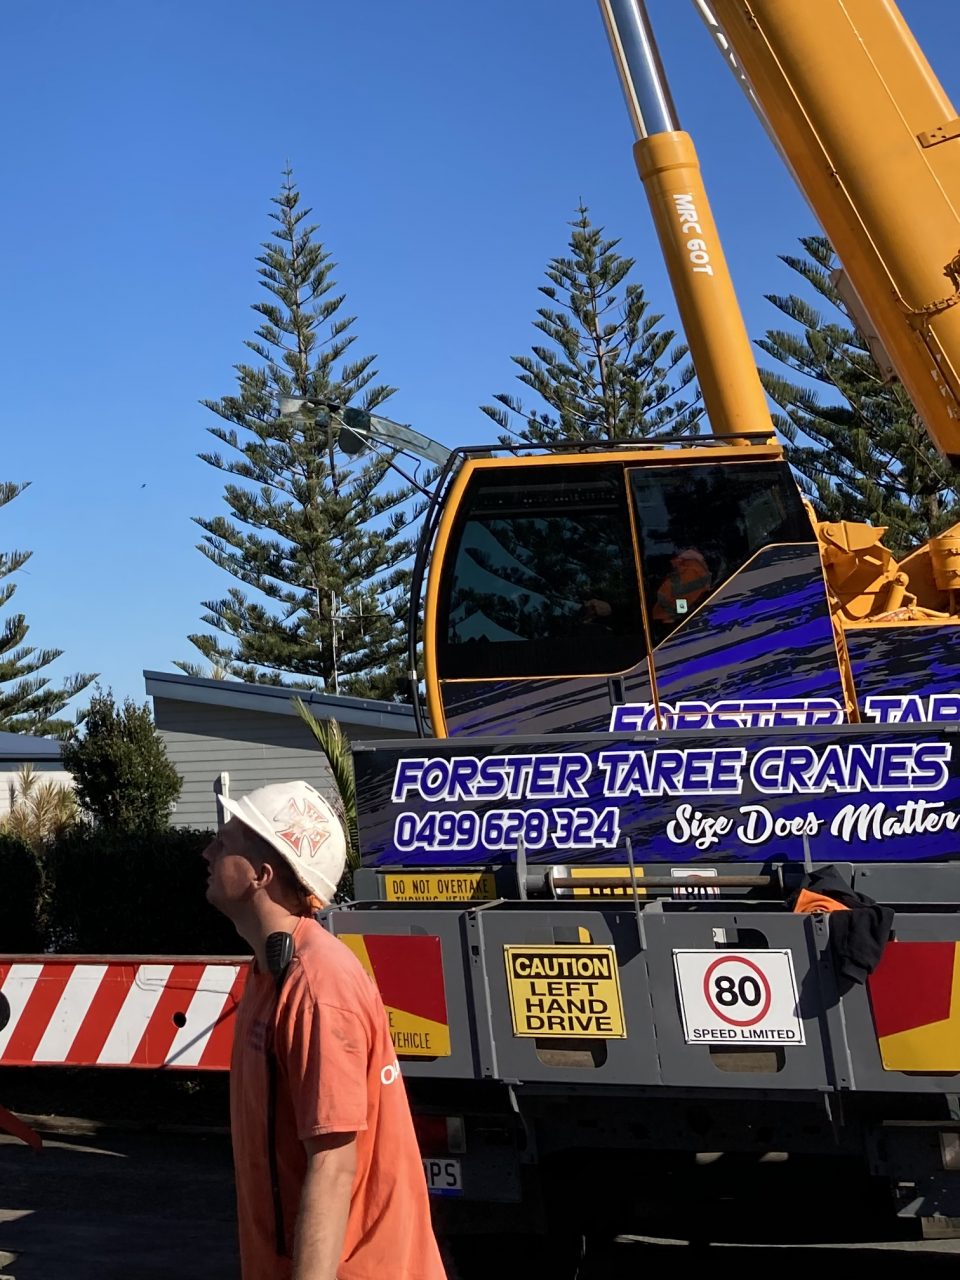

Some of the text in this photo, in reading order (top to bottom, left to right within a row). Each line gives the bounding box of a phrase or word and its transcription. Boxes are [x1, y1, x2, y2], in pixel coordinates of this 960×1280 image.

[673, 193, 714, 276] MRC 60T
[391, 742, 953, 803] FORSTER TAREE CRANES
[393, 806, 621, 852] 0499 628 324
[666, 804, 733, 849] Size
[737, 805, 824, 844] Does
[393, 879, 489, 894] DO NOT OVERTAKE
[515, 957, 610, 976] CAUTION
[530, 981, 599, 997] LEFT
[714, 975, 762, 1007] 80
[525, 998, 608, 1014] HAND
[526, 1015, 613, 1031] DRIVE
[693, 1028, 795, 1039] SPEED LIMITED
